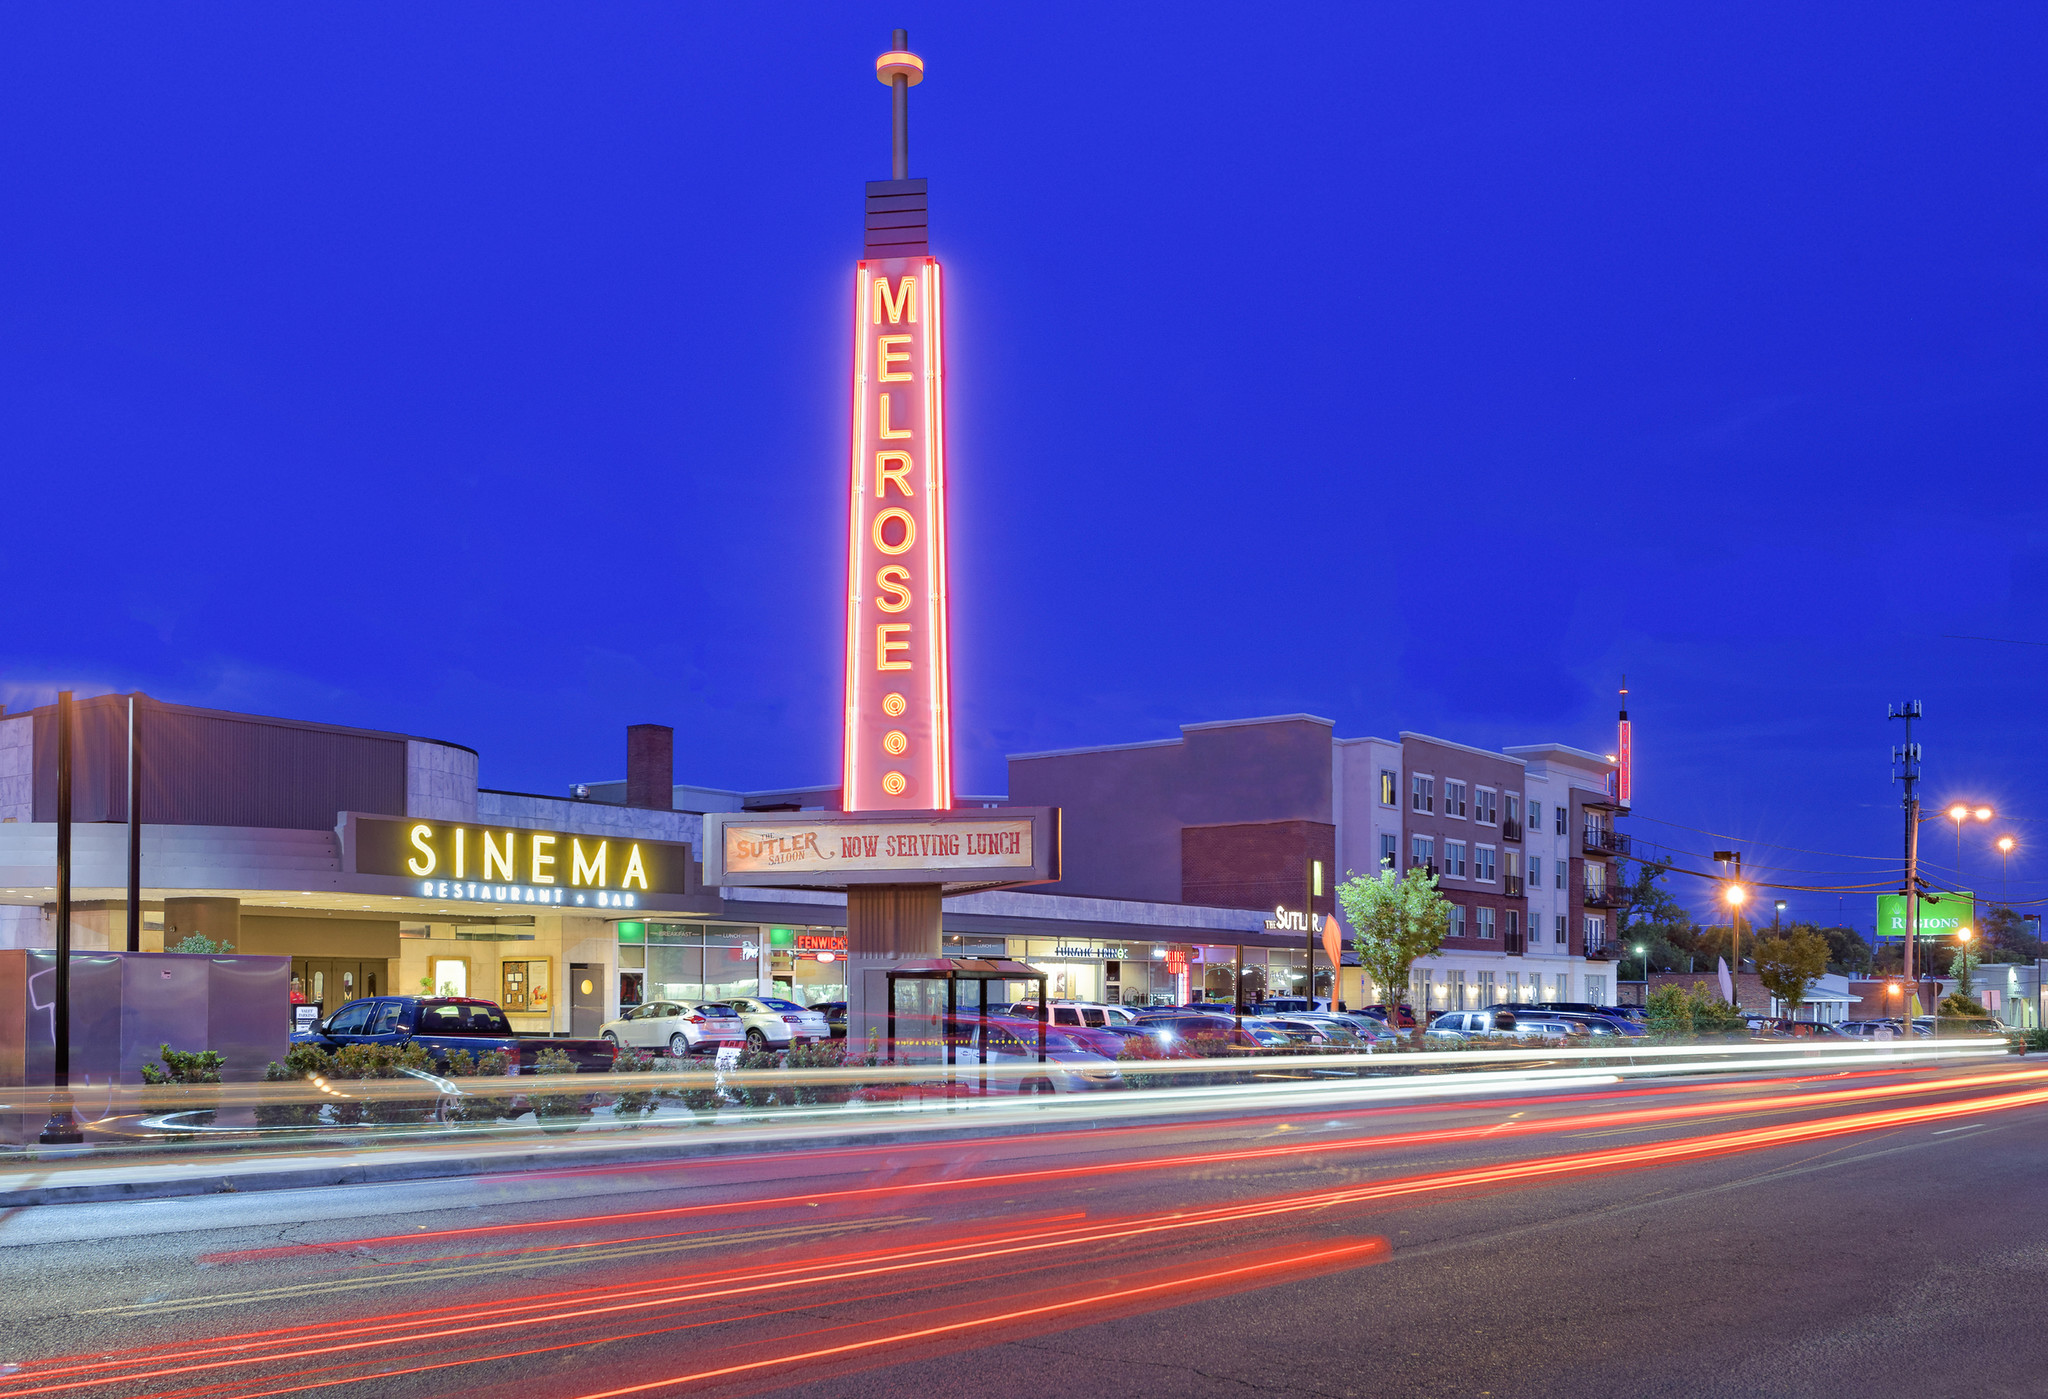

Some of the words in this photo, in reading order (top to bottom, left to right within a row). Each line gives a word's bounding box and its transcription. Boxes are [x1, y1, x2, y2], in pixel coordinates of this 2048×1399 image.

[871, 275, 919, 672] MELROSE
[737, 832, 835, 860] SUTLER
[761, 832, 775, 840] THE
[841, 835, 879, 858] NOW
[886, 833, 959, 857] SERVING
[967, 832, 1020, 855] LUNCH
[408, 824, 648, 889] SINEMA
[768, 851, 805, 865] SALOON
[423, 882, 563, 904] RESTAURANT
[598, 892, 635, 907] BAR
[1264, 920, 1276, 929] THE
[1275, 905, 1323, 932] SUTLR
[1891, 917, 1960, 929] RGIONS
